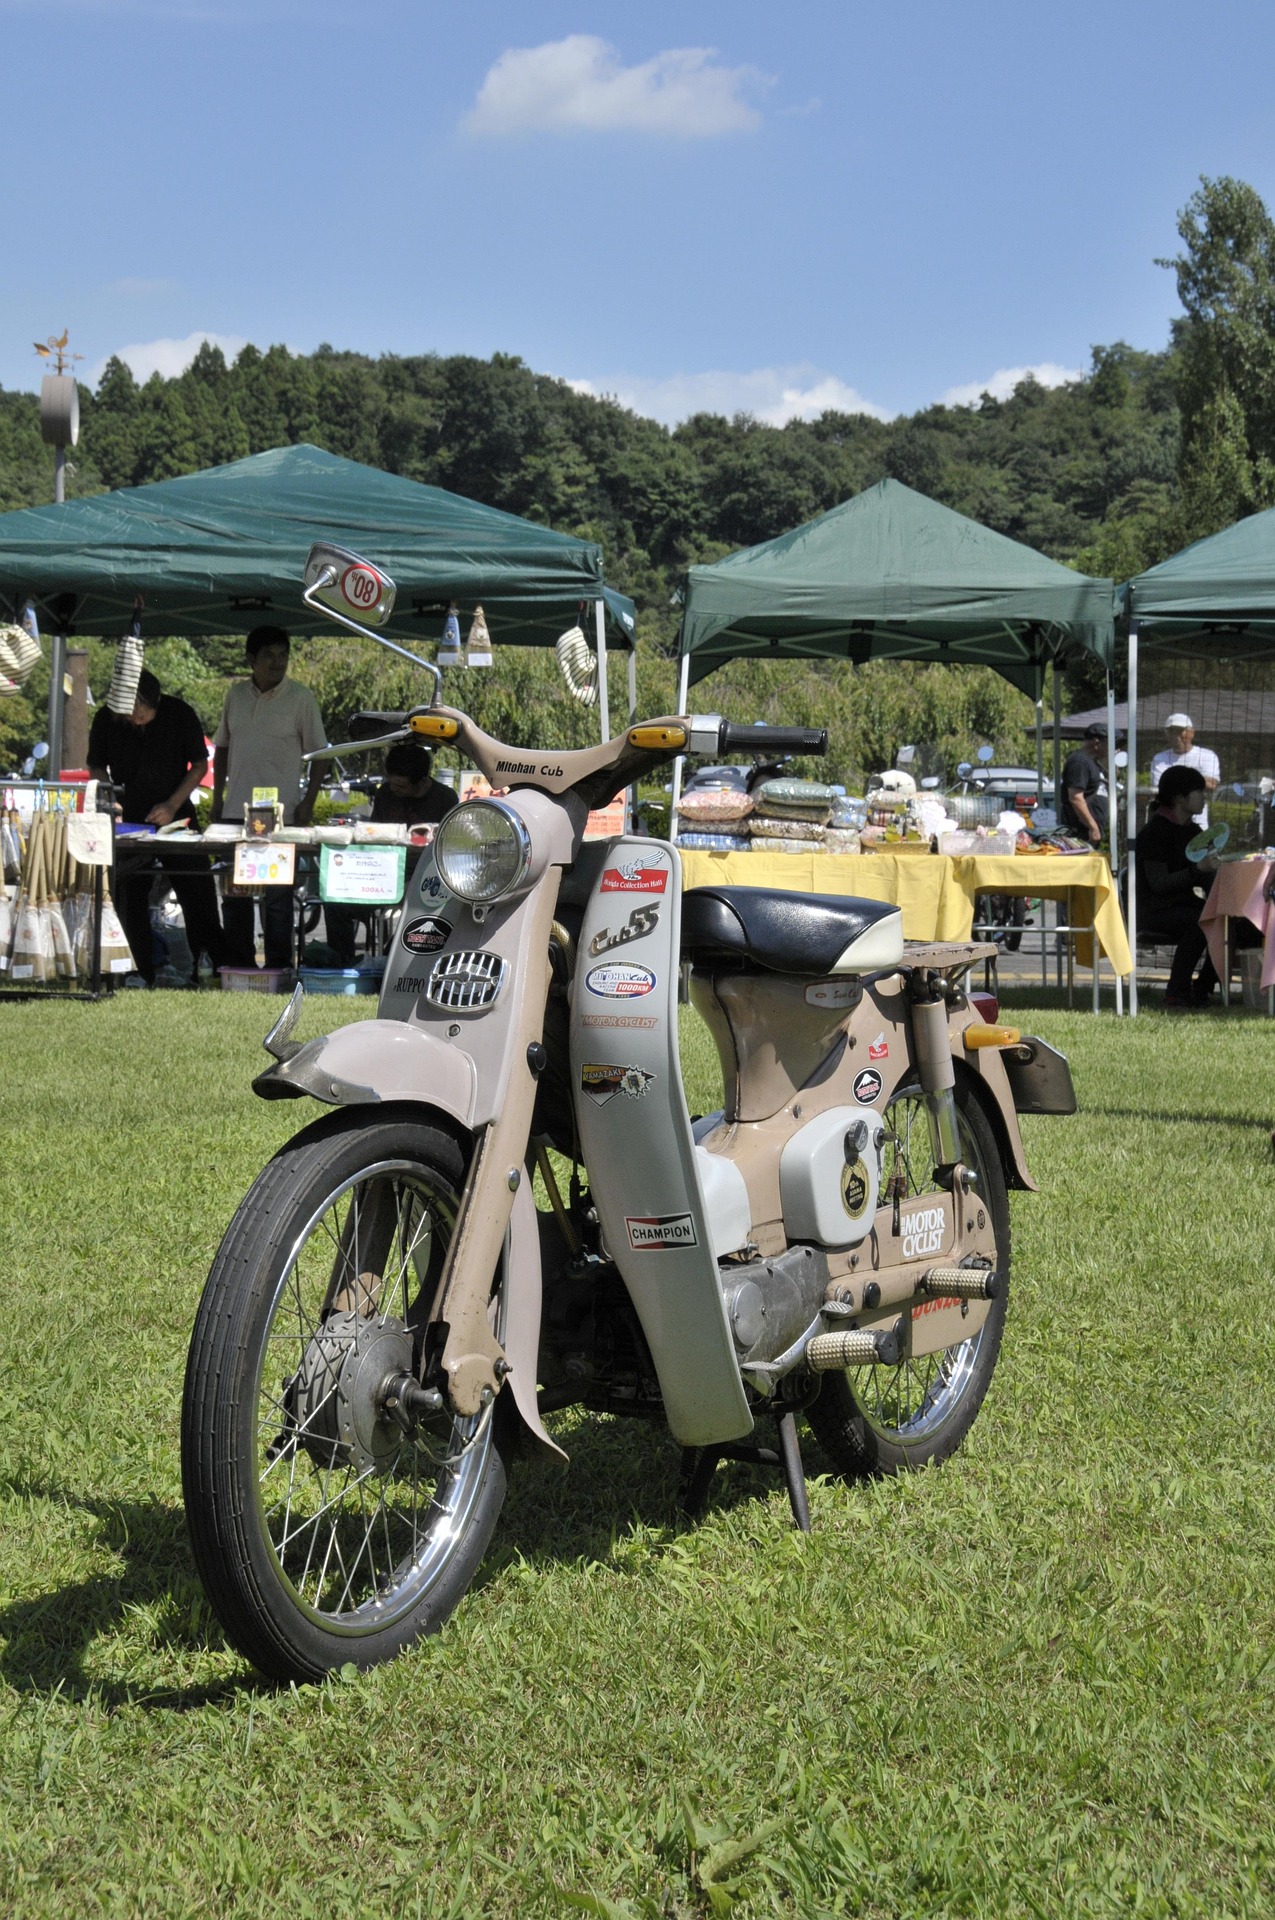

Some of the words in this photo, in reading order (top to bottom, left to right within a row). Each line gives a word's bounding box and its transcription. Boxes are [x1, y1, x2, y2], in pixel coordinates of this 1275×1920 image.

[495, 760, 536, 775] Mitohan
[540, 765, 564, 777] Cub
[620, 880, 650, 890] Collection
[650, 878, 663, 888] Hall
[618, 983, 649, 992] 1000KM
[585, 1067, 622, 1080] YAMAZAKI
[905, 1207, 946, 1236] MOTOR
[632, 1225, 691, 1240] CHAMPION
[902, 1228, 945, 1258] CYCLIST
